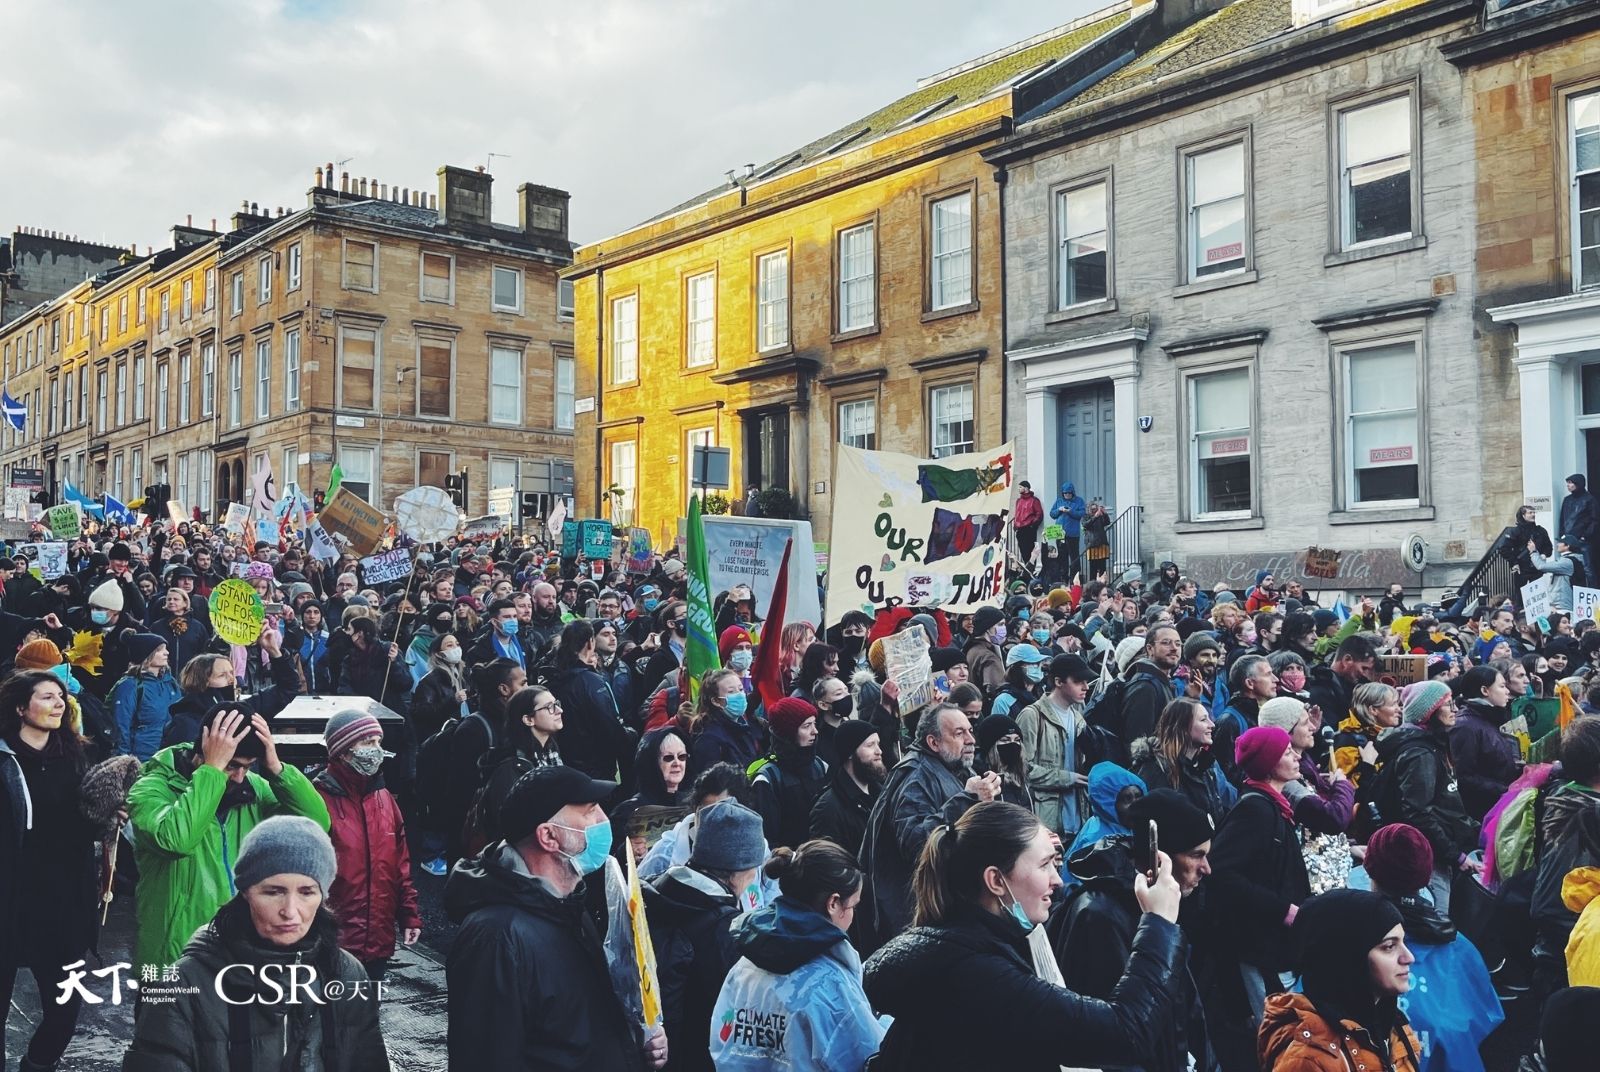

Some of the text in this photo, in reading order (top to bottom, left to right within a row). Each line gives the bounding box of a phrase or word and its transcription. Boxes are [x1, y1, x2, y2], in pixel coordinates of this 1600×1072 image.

[1371, 449, 1410, 460] MEARS
[729, 539, 744, 548] EVERY
[874, 512, 924, 562] OUR
[373, 549, 404, 565] STOP
[724, 556, 736, 564] LOSE
[736, 557, 750, 566] THEIR
[390, 563, 412, 578] FUELS
[725, 565, 734, 573] THE
[734, 565, 753, 575] CLIMATE
[219, 583, 255, 606] STAND
[216, 598, 254, 624] UP FOR
[210, 611, 256, 643] NATURE
[1383, 658, 1415, 673] LIMATE
[733, 1024, 786, 1053] FRESK
